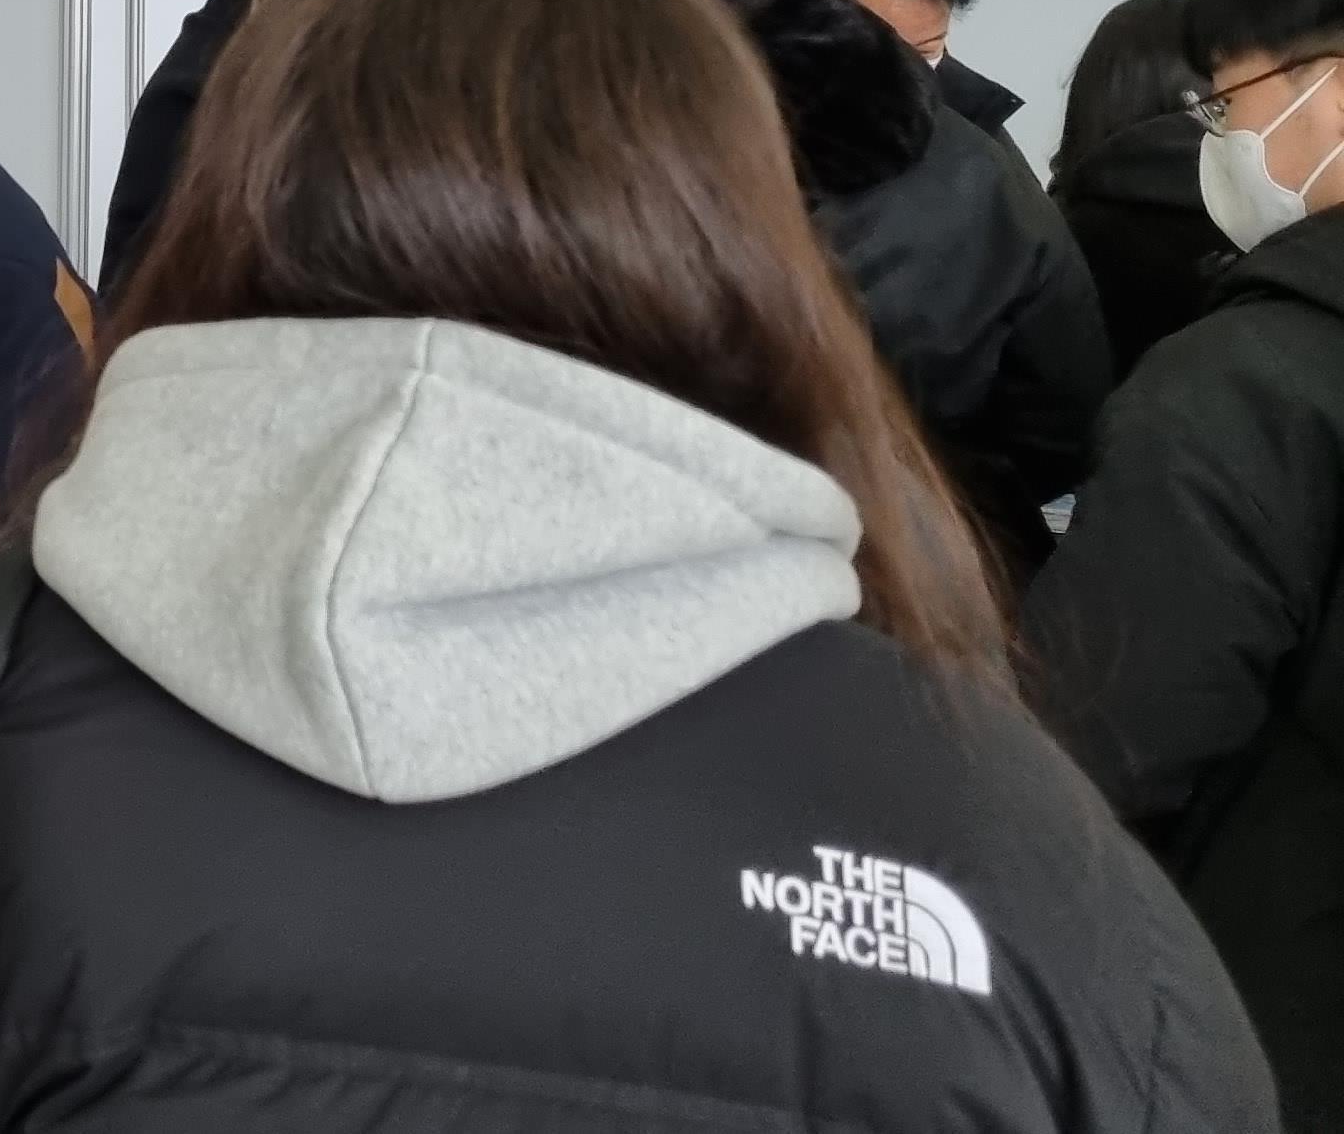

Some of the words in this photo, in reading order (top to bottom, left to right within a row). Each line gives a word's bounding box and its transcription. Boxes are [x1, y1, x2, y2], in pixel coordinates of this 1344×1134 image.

[813, 845, 904, 893] THE
[740, 869, 906, 936] NORTH
[790, 915, 909, 975] FACE
